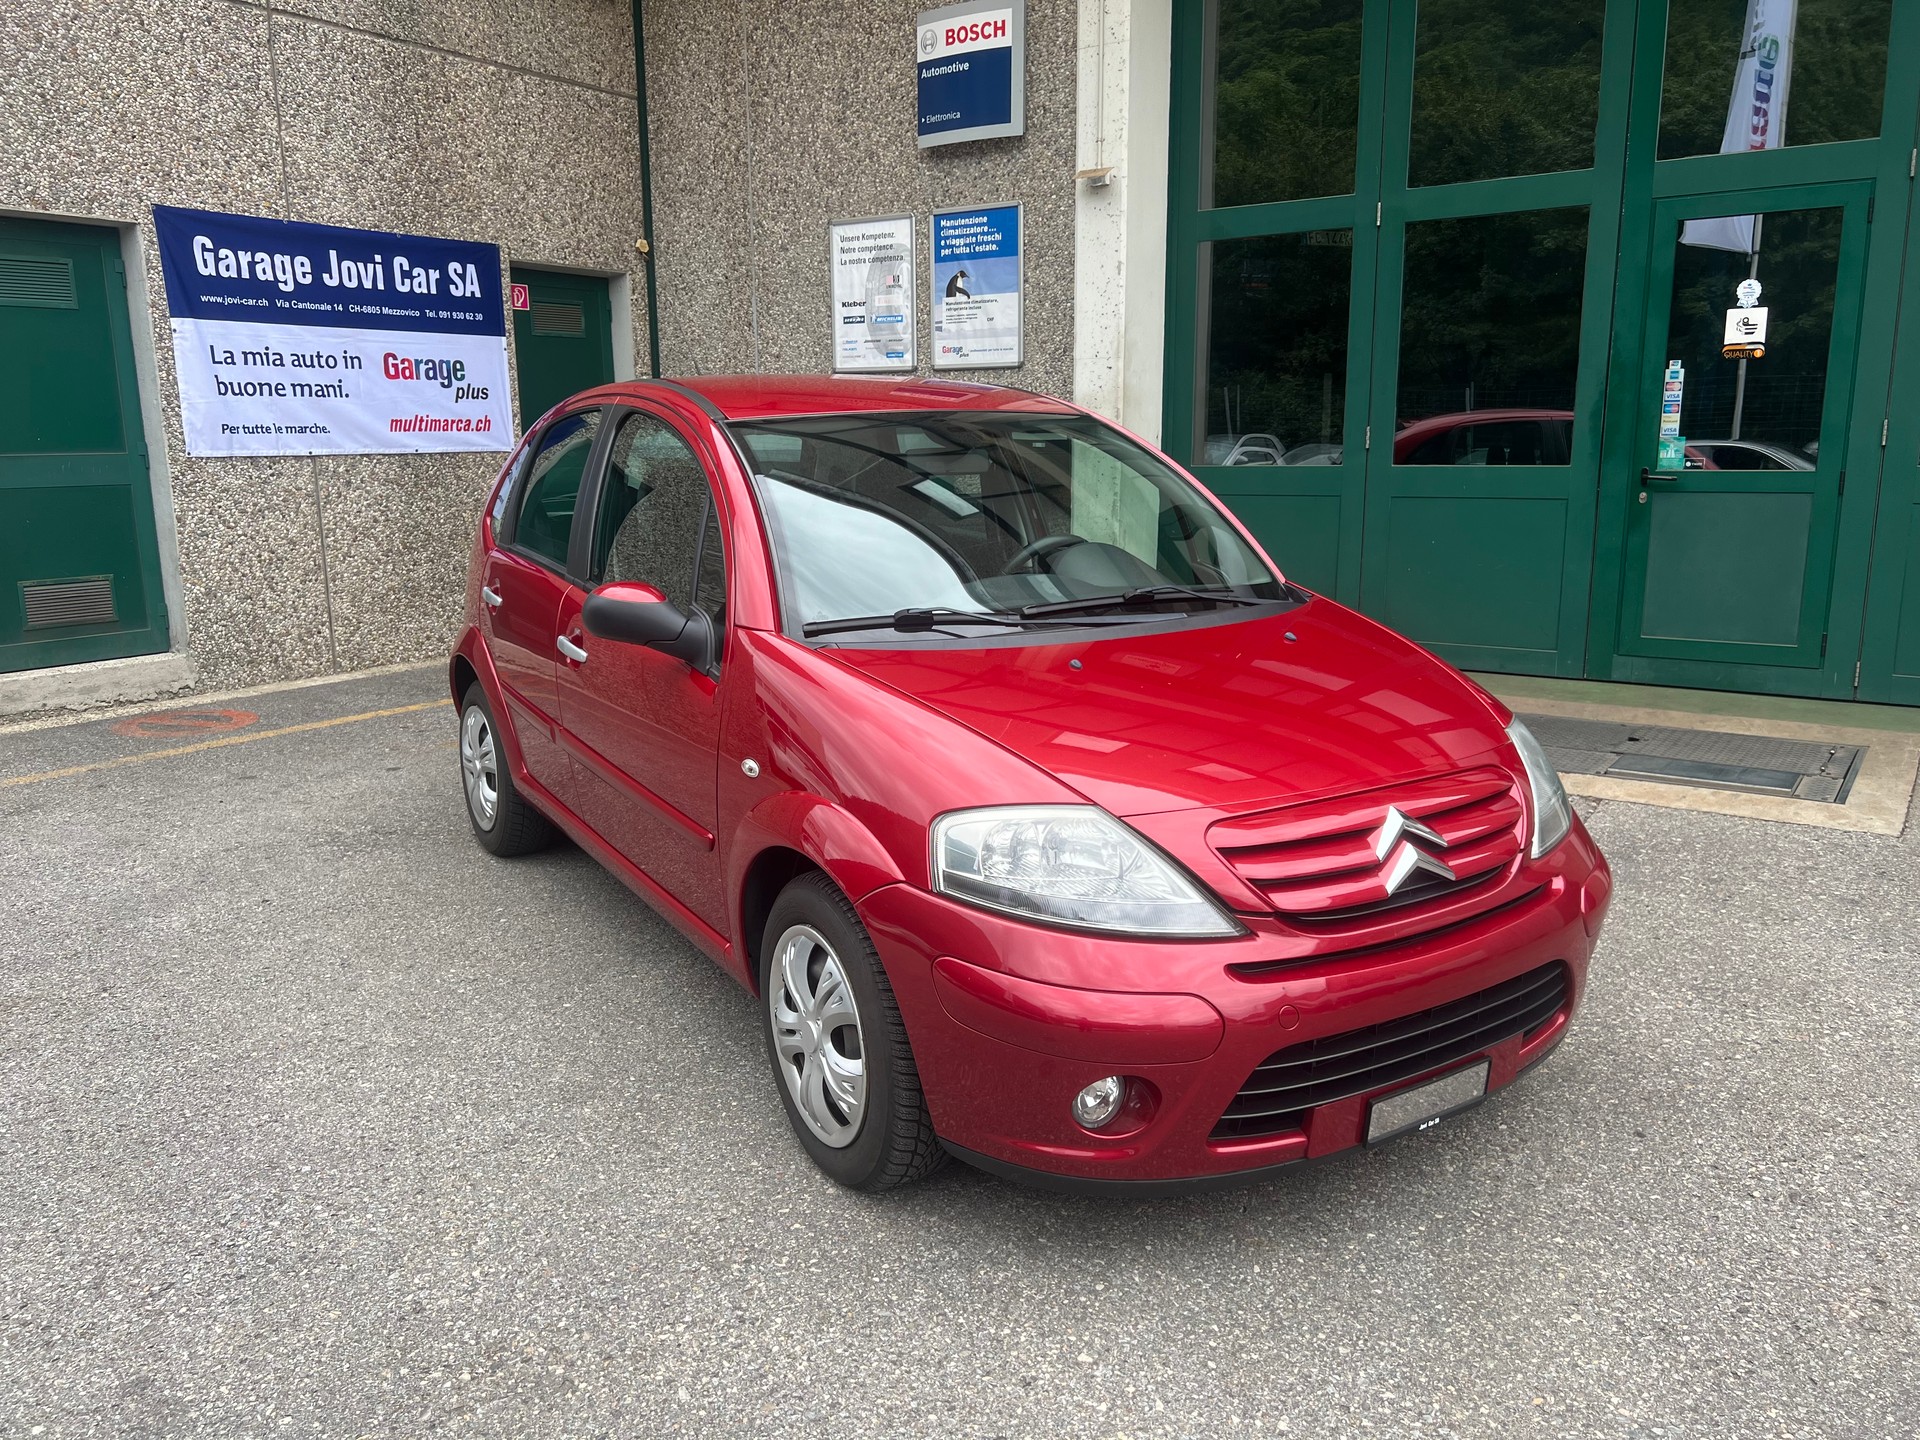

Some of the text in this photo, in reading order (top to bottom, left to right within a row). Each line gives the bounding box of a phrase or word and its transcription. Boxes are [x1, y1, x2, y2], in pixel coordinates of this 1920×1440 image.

[945, 19, 1006, 47] BOSCH
[921, 61, 970, 79] Automotive
[926, 110, 961, 124] Elettronica
[940, 216, 988, 227] Manutenzione
[840, 232, 896, 243] Unsere Kompetenz.
[946, 236, 976, 246] viaggiate
[977, 232, 1002, 242] freschi
[840, 246, 856, 254] Notre
[940, 243, 998, 257] per tutta l'estate.
[192, 235, 482, 298] Garage Jovi Car SA
[840, 258, 847, 266] La
[868, 254, 905, 264] competenza.
[200, 295, 269, 307] www.jovi-car.ch
[276, 299, 290, 308] Via
[291, 300, 332, 311] Cantonale
[334, 304, 343, 312] 14
[348, 304, 381, 314] CH-6805
[382, 306, 420, 317] Mezzovico
[424, 310, 438, 318] Tel.
[438, 311, 450, 319] 091
[452, 312, 464, 320] 930
[474, 313, 483, 321] 30
[210, 344, 362, 370] La mia auto in
[942, 346, 963, 355] Garage
[1724, 350, 1754, 358] QUALITY
[383, 352, 466, 388] Garage
[214, 374, 350, 398] buone mani.
[454, 383, 489, 404] plus
[221, 423, 330, 434] Per tutte le marche.
[390, 414, 492, 433] multimarca.ch
